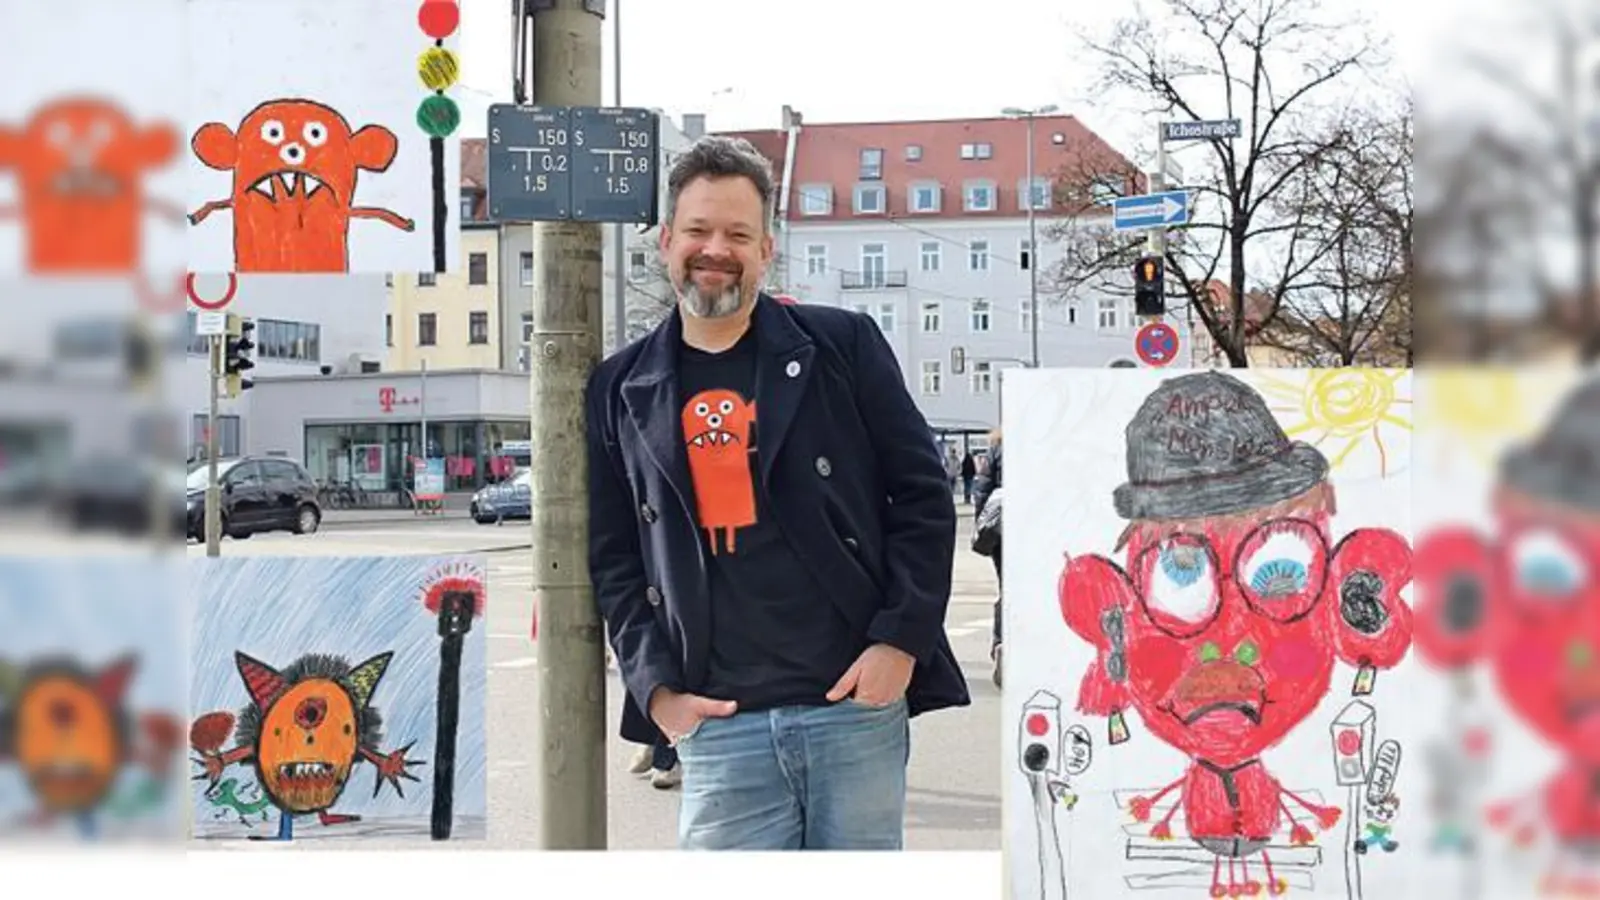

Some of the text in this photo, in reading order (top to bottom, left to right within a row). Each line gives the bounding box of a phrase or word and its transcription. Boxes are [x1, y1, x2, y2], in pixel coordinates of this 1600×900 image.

[538, 129, 567, 145] 150
[574, 131, 648, 148] S 150
